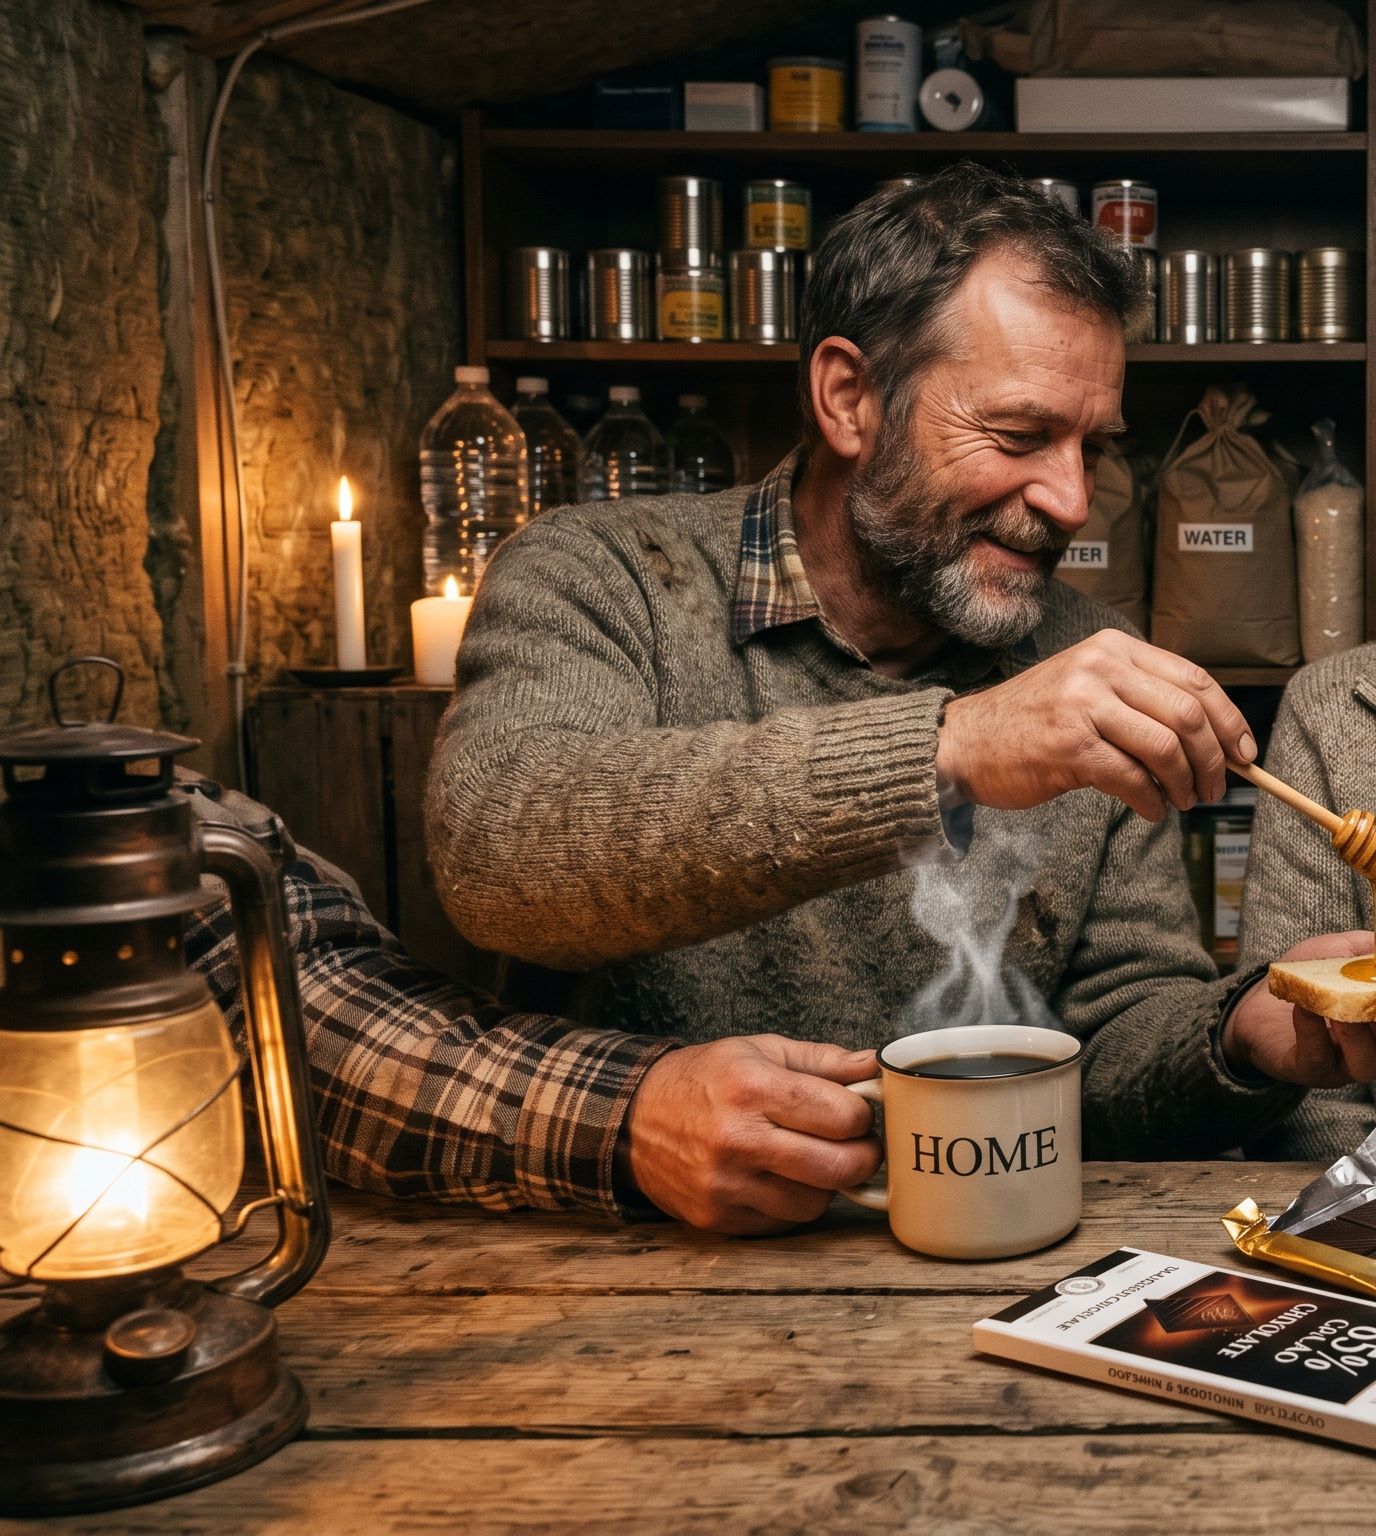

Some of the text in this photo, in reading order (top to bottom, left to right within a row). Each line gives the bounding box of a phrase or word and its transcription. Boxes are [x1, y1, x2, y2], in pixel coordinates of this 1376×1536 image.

[1184, 530, 1247, 546] WATER
[1060, 547, 1102, 562] TER
[911, 1125, 1059, 1177] HOME
